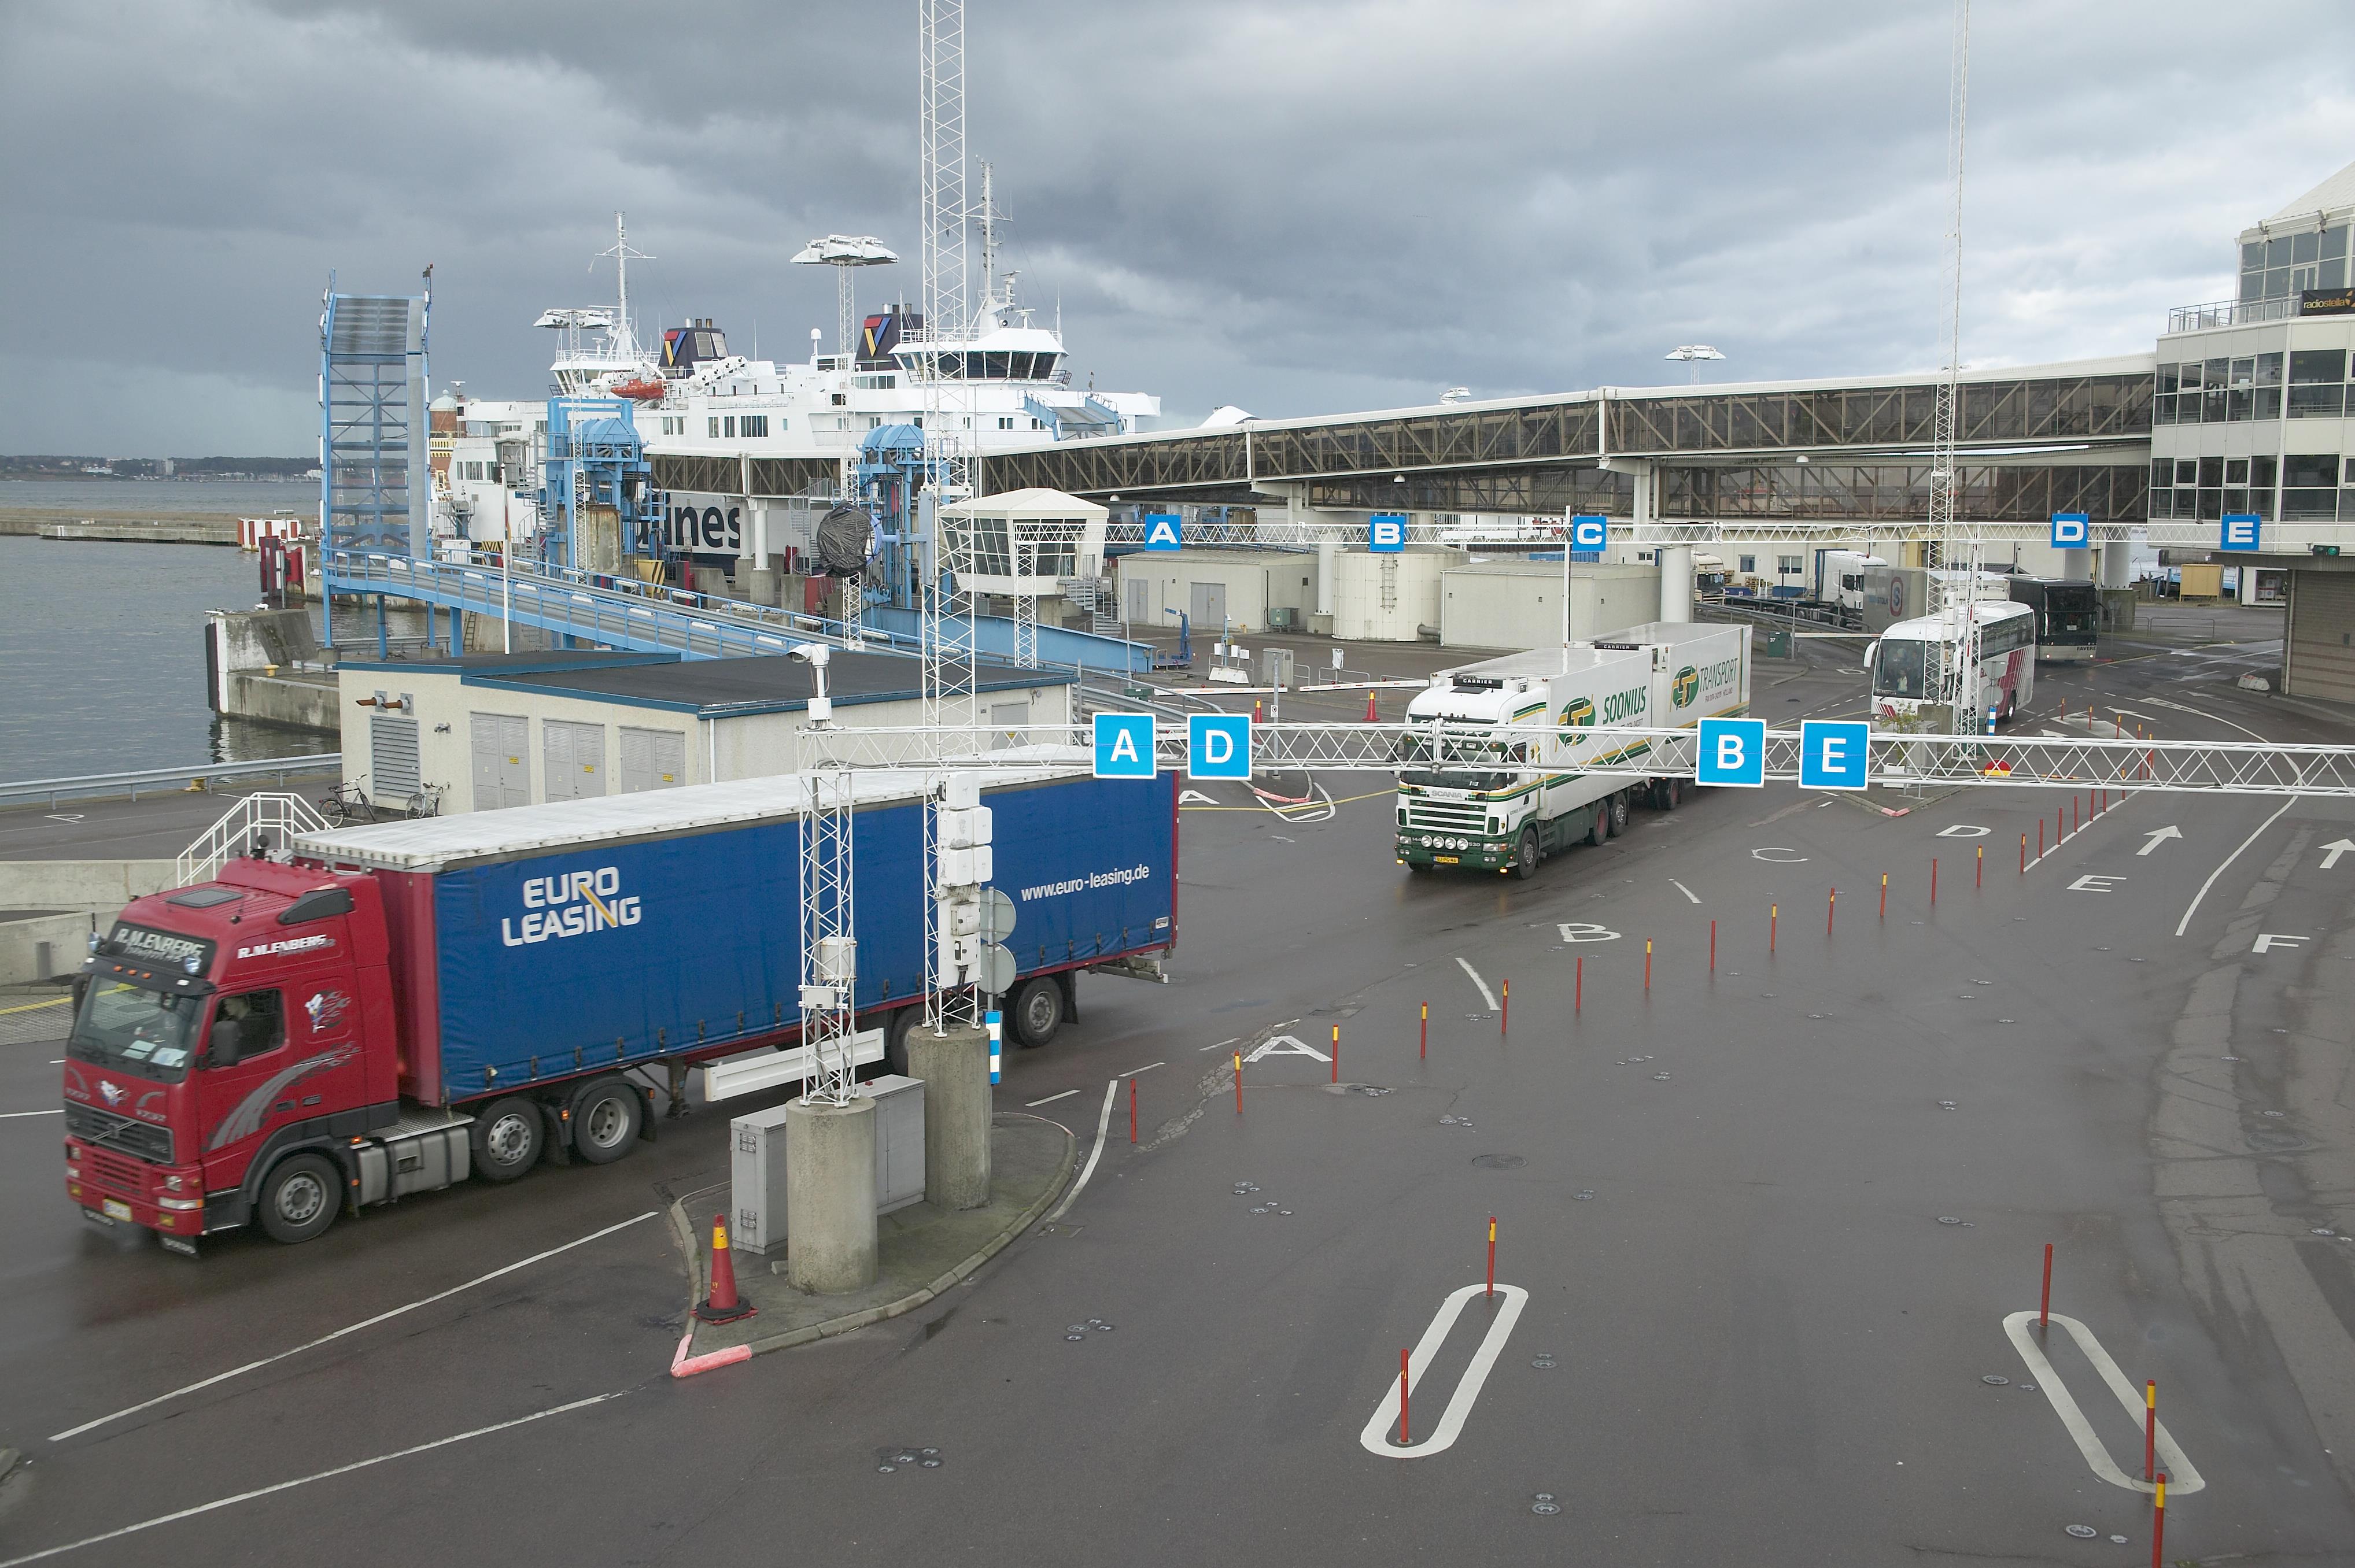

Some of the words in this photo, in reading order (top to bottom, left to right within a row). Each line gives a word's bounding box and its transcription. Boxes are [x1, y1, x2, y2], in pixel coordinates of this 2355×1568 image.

[2304, 298, 2345, 309] radiostella
[1148, 522, 1178, 544] A
[1374, 523, 1401, 545] B
[1577, 523, 1603, 545] C
[2055, 521, 2084, 542] D
[2228, 522, 2253, 543] E
[1700, 657, 1738, 693] TRANSPORT
[1603, 685, 1647, 725] SOONIUS
[1110, 728, 1139, 762] A
[1206, 730, 1234, 763] D
[1717, 735, 1745, 770] B
[1822, 738, 1847, 773] E
[1178, 790, 1220, 804] A
[1431, 790, 1463, 799] SCANIA
[1935, 825, 1992, 837] D
[523, 866, 620, 909] EURO
[1021, 863, 1150, 901] www.euro-leasing.de
[2066, 875, 2127, 893] E
[502, 896, 641, 947] LEASING
[1557, 923, 1622, 942] B
[2252, 934, 2310, 953] F
[1243, 1036, 1334, 1063] A
